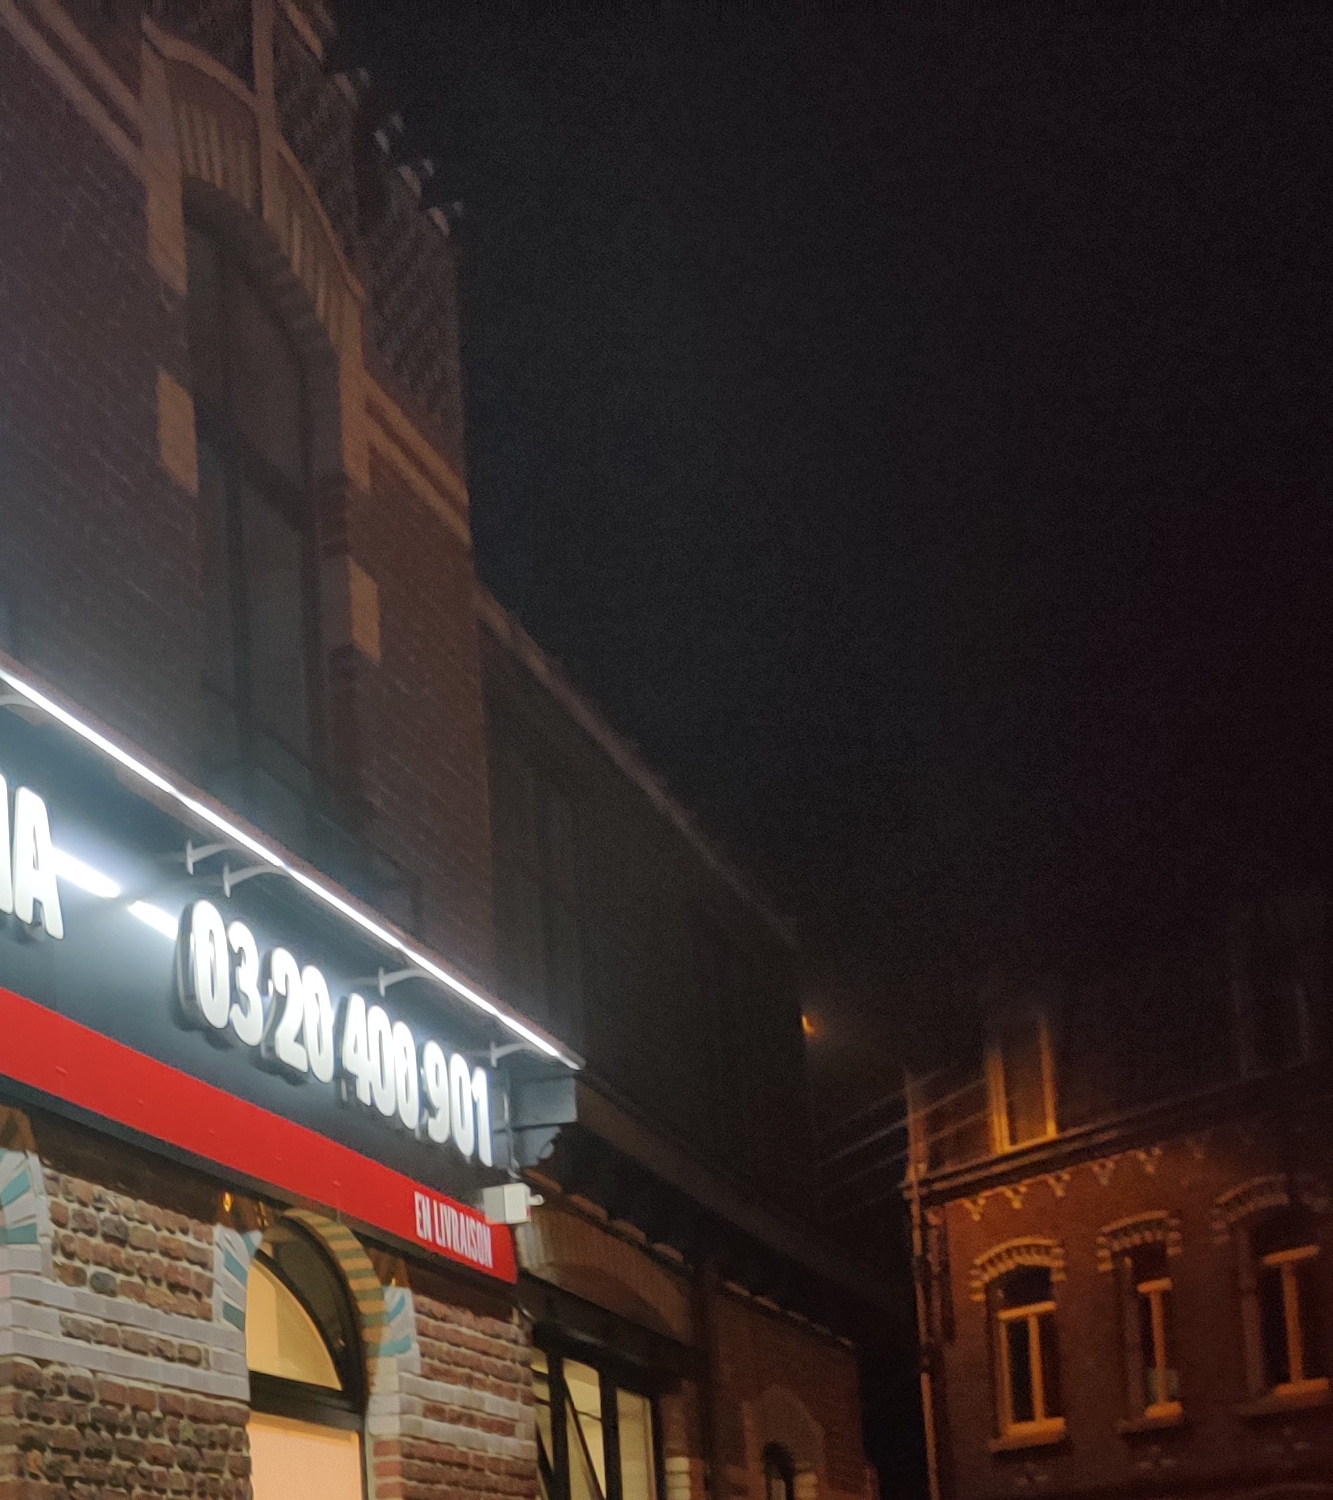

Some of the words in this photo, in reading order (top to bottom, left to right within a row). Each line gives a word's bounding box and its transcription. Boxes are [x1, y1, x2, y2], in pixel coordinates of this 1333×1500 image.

[191, 899, 264, 1047] 03
[270, 947, 334, 1084] 20
[342, 992, 420, 1131] 400
[421, 1040, 494, 1168] 901
[433, 1199, 493, 1269] LIVRAISON
